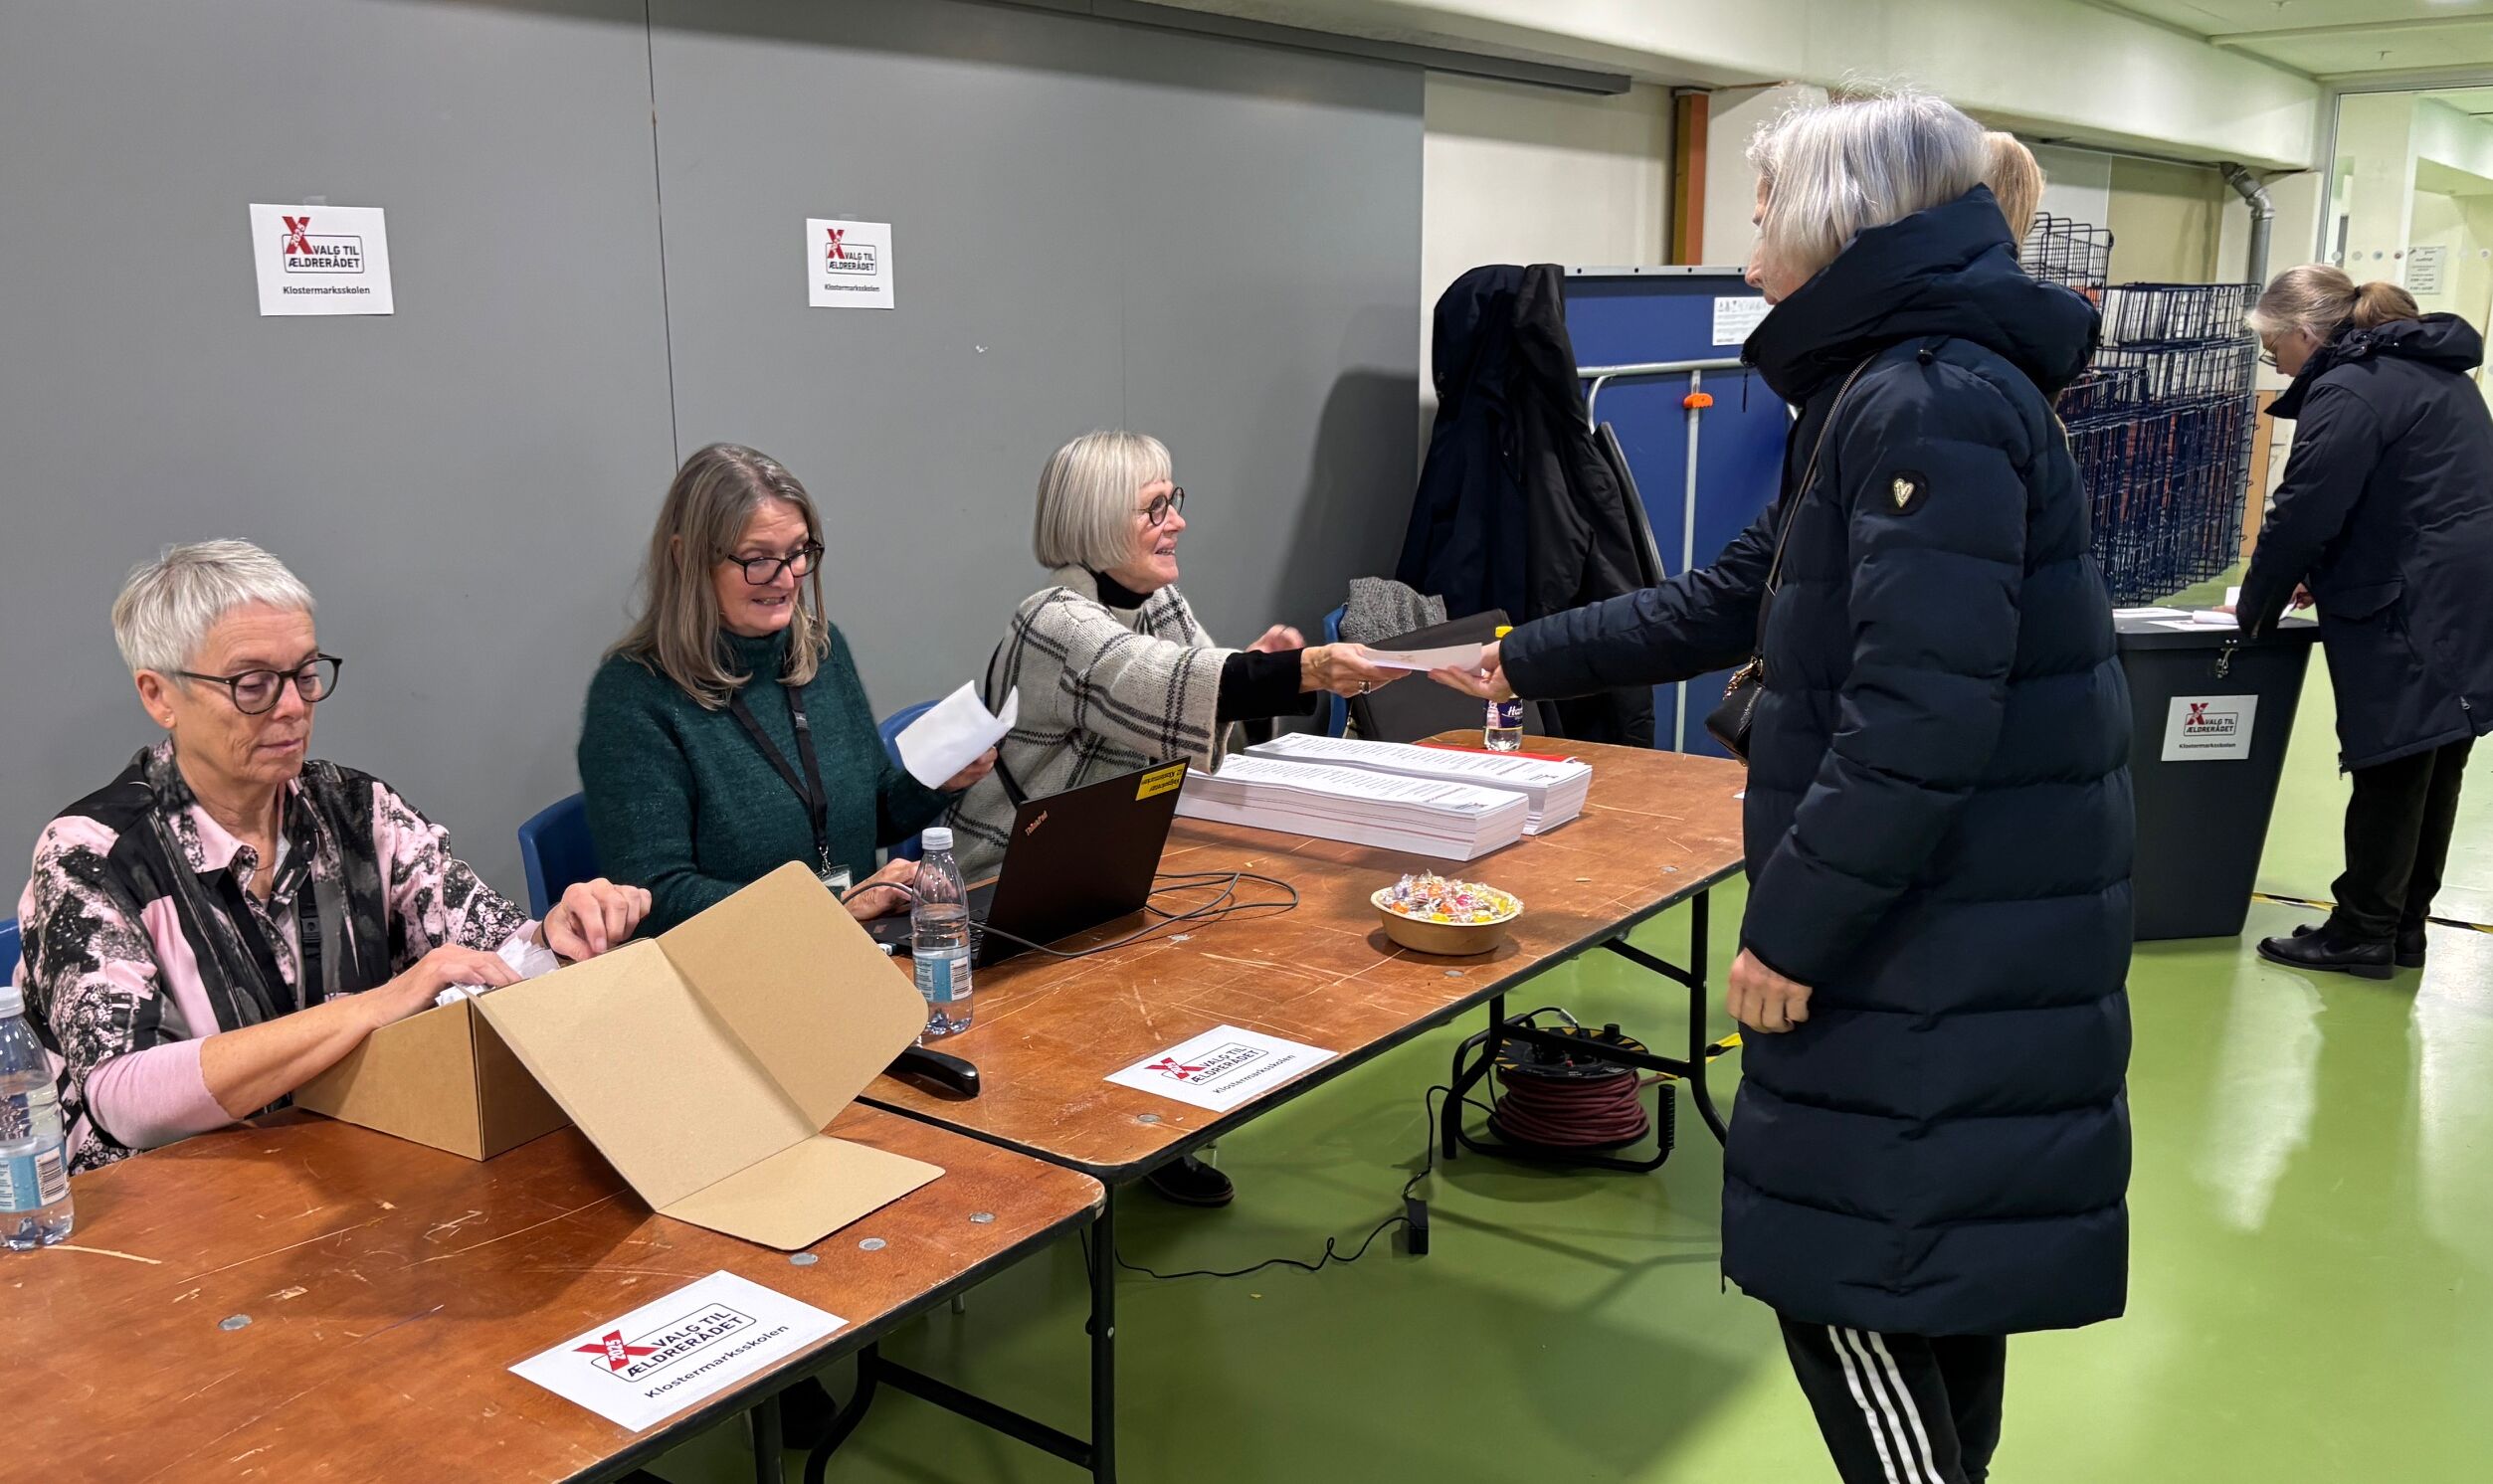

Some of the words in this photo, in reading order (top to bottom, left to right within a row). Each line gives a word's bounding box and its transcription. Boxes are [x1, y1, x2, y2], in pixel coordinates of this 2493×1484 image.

[288, 256, 360, 268] ÆLDRERÅDET
[313, 246, 340, 256] VALG
[343, 246, 359, 256] TIL
[1199, 1053, 1231, 1067] VALG
[1213, 1054, 1296, 1094] Klostermarksskolen
[651, 1323, 701, 1349] VALG
[699, 1311, 732, 1325] TIL
[605, 1339, 626, 1362] 2025
[626, 1316, 744, 1378] ÆLDRERÅDET
[645, 1325, 789, 1398] Klostermarksskolen
